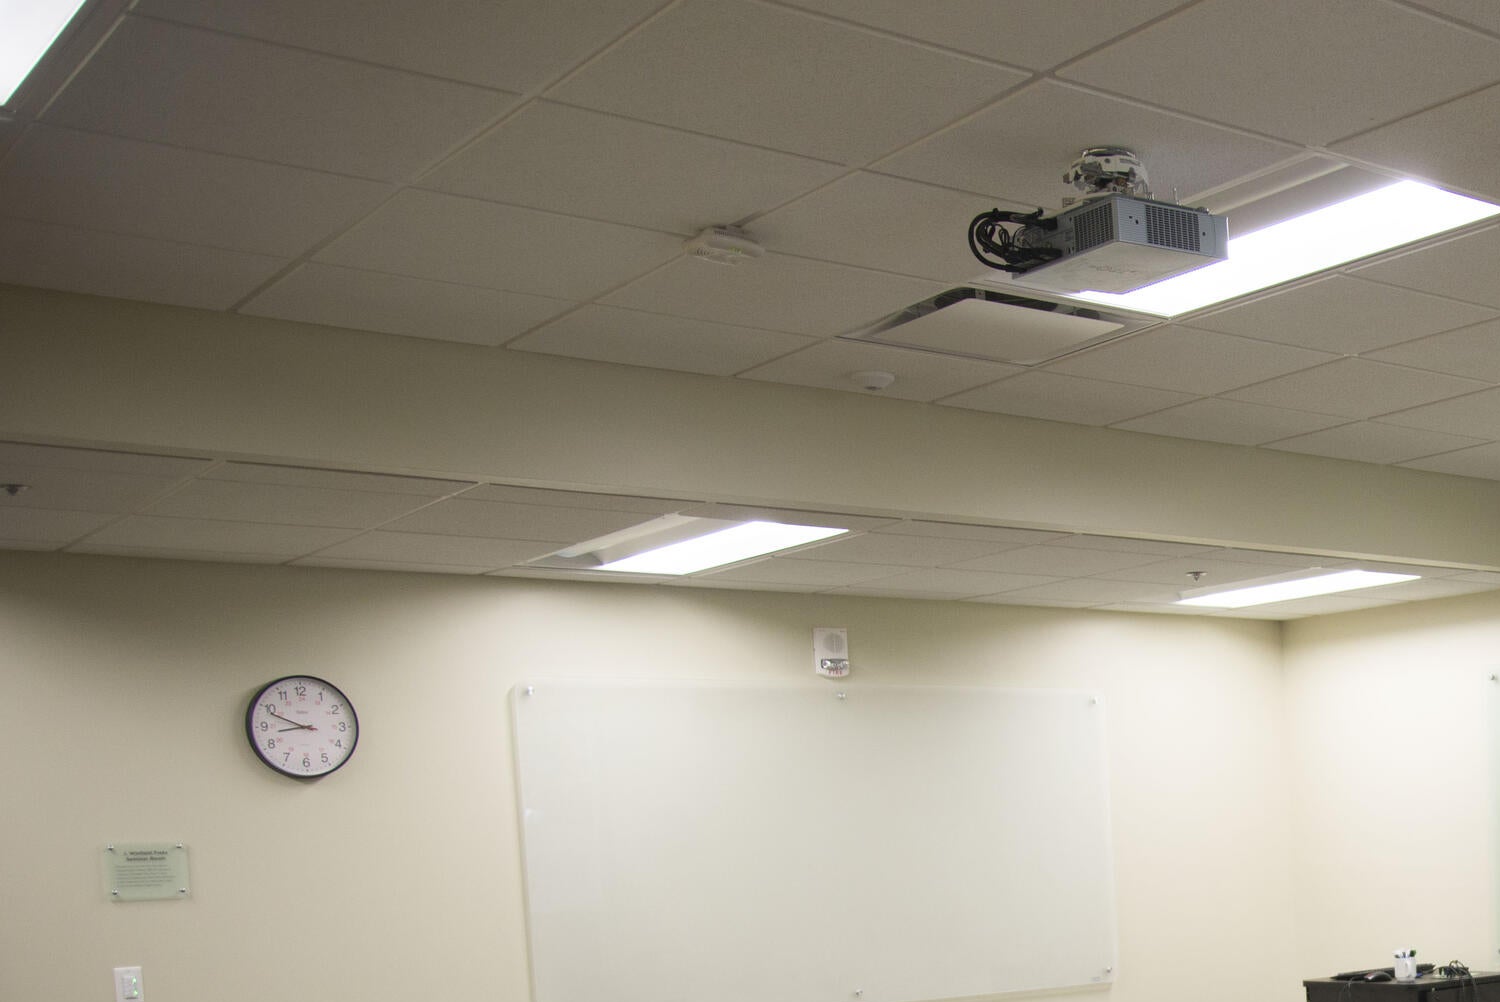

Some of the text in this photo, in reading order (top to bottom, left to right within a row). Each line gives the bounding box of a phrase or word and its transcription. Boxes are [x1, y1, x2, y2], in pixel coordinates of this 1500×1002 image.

[278, 690, 288, 701] 11
[294, 686, 306, 696] 12
[318, 692, 323, 701] 1
[265, 703, 276, 714] 10
[331, 704, 339, 715] 2
[260, 722, 269, 732] 9
[338, 722, 346, 732] 3
[268, 738, 276, 749] 8
[334, 739, 342, 749] 4
[283, 752, 291, 762] 7
[321, 752, 329, 763] 5
[302, 757, 311, 768] 6
